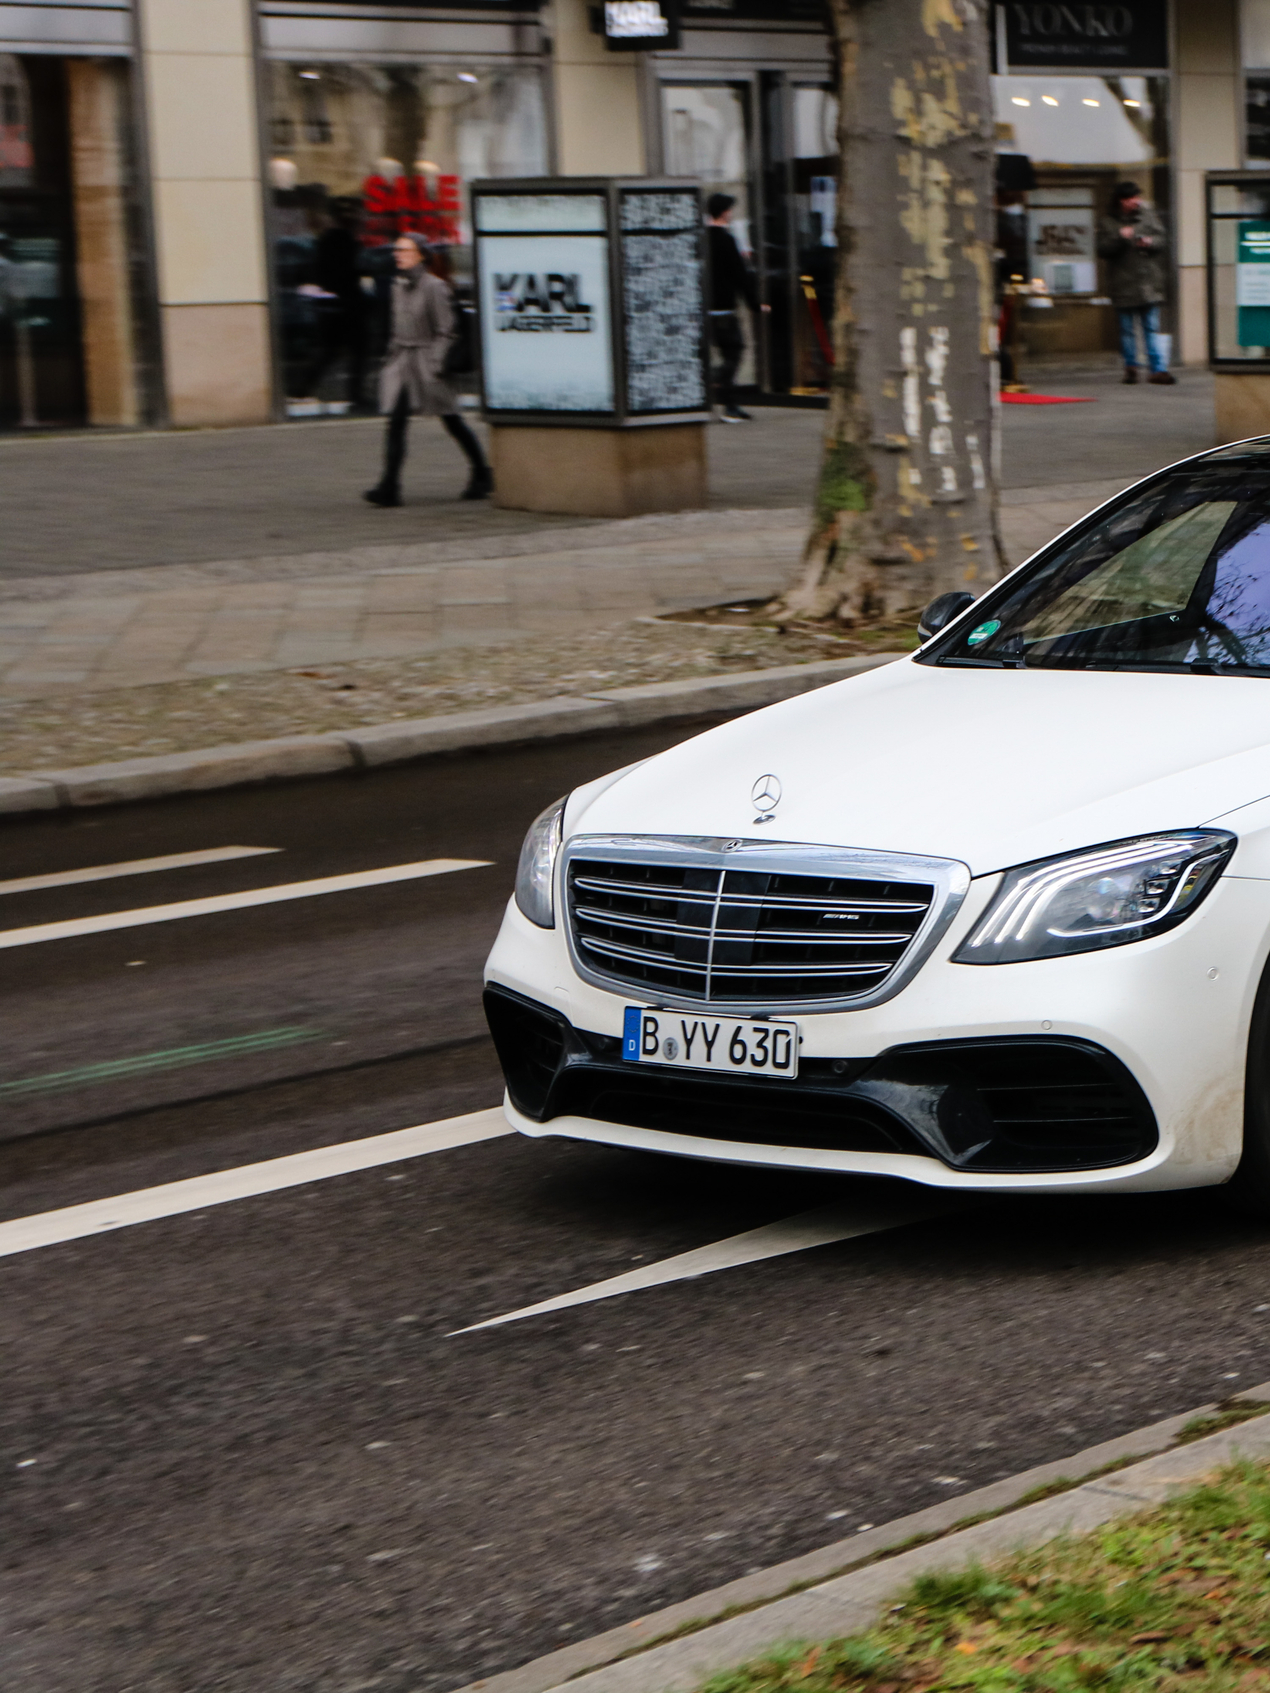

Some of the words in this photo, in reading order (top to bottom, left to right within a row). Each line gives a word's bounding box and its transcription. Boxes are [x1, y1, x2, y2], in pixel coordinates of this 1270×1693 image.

[364, 174, 462, 213] SALE
[493, 273, 592, 312] KARL
[628, 1039, 636, 1051] D
[642, 1016, 659, 1055] B
[681, 1020, 720, 1062] YY
[729, 1025, 791, 1069] 630
